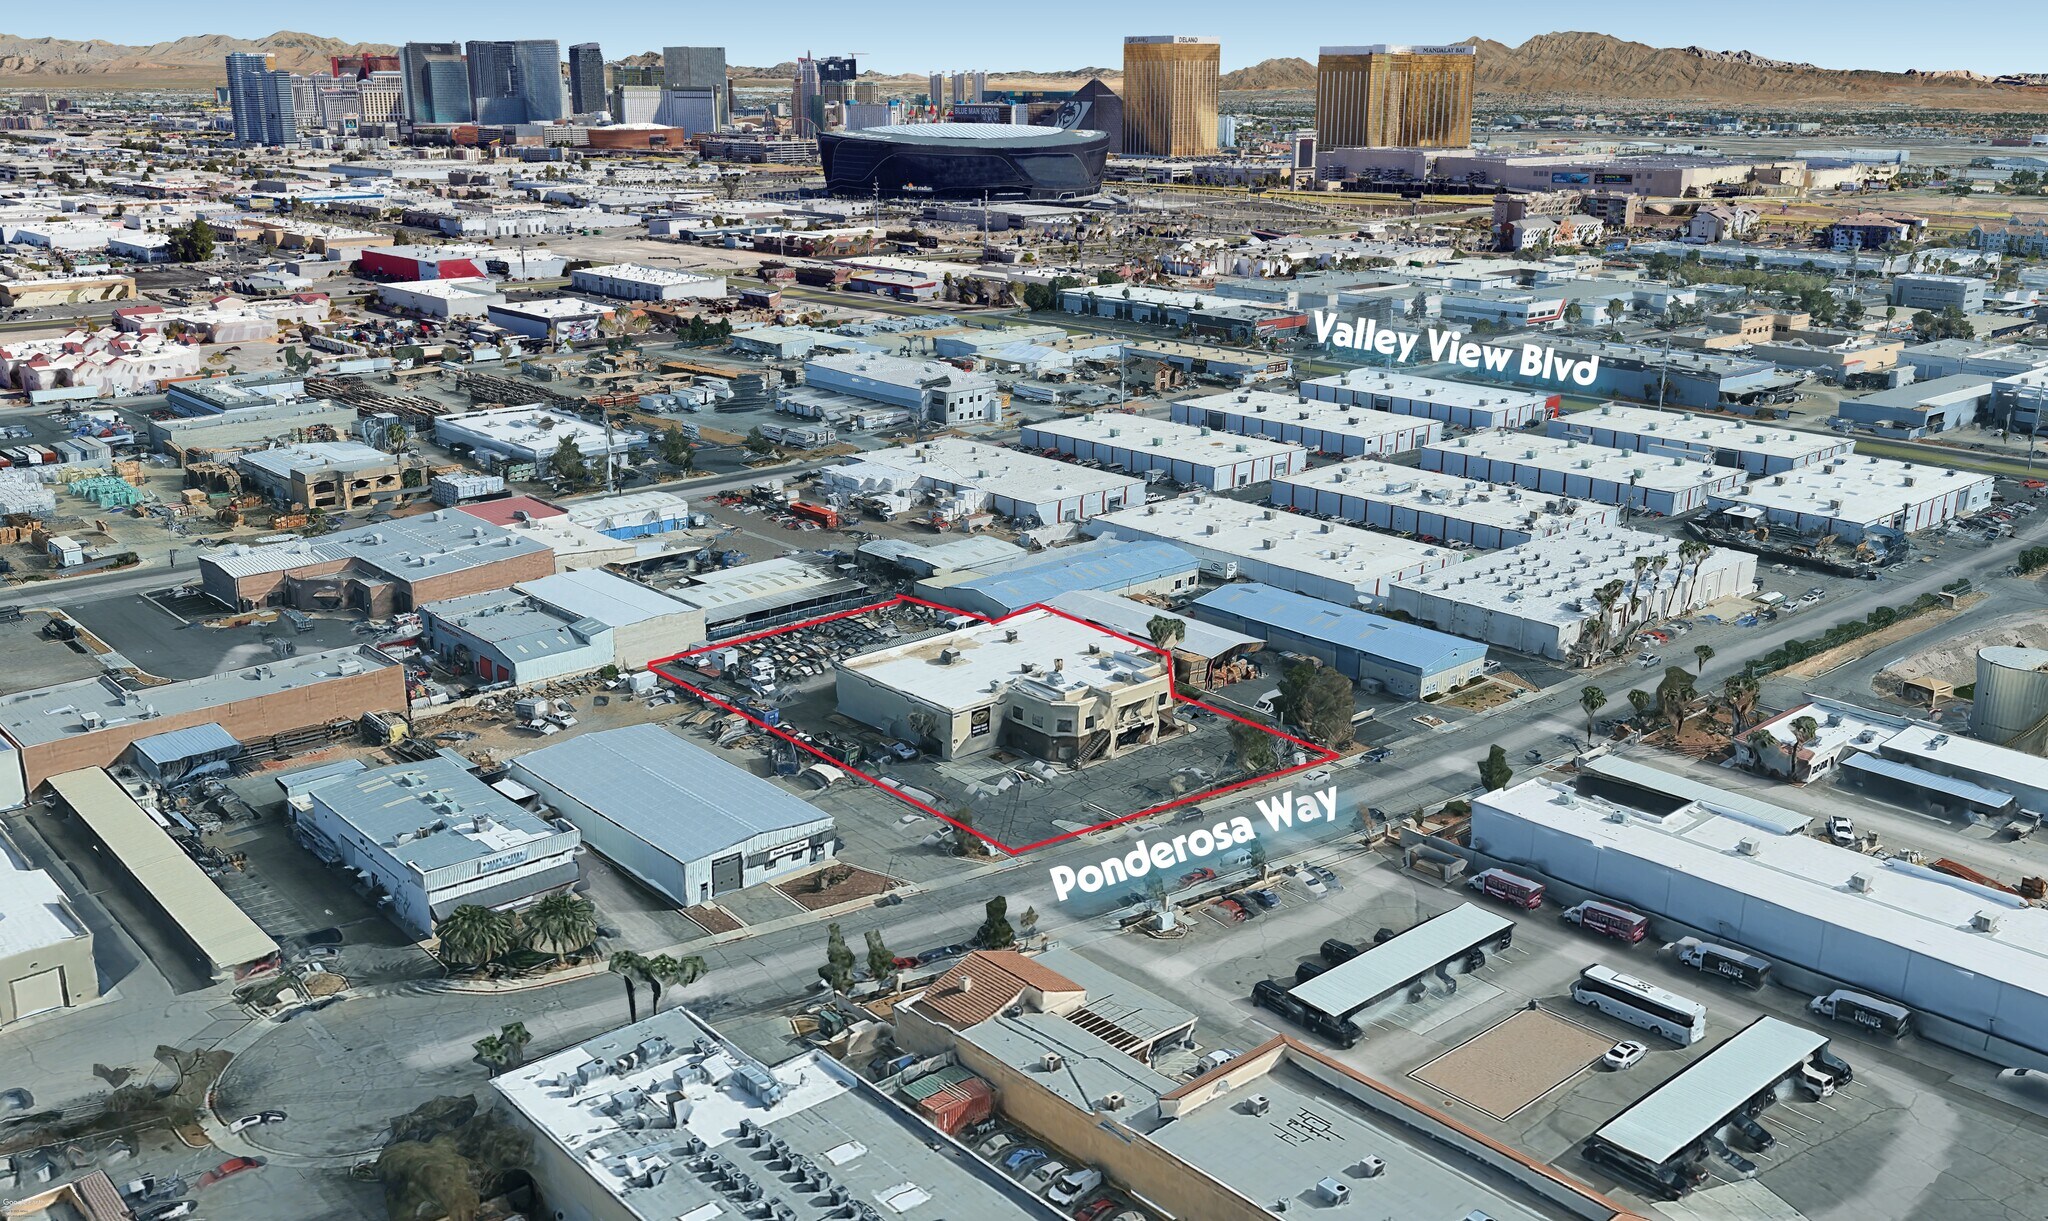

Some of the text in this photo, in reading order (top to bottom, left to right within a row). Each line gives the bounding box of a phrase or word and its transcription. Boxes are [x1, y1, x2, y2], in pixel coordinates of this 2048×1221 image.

[954, 106, 967, 115] BLUE
[968, 106, 980, 115] MAN
[1718, 962, 1744, 979] TOURS
[1854, 1009, 1882, 1029] TOURS
